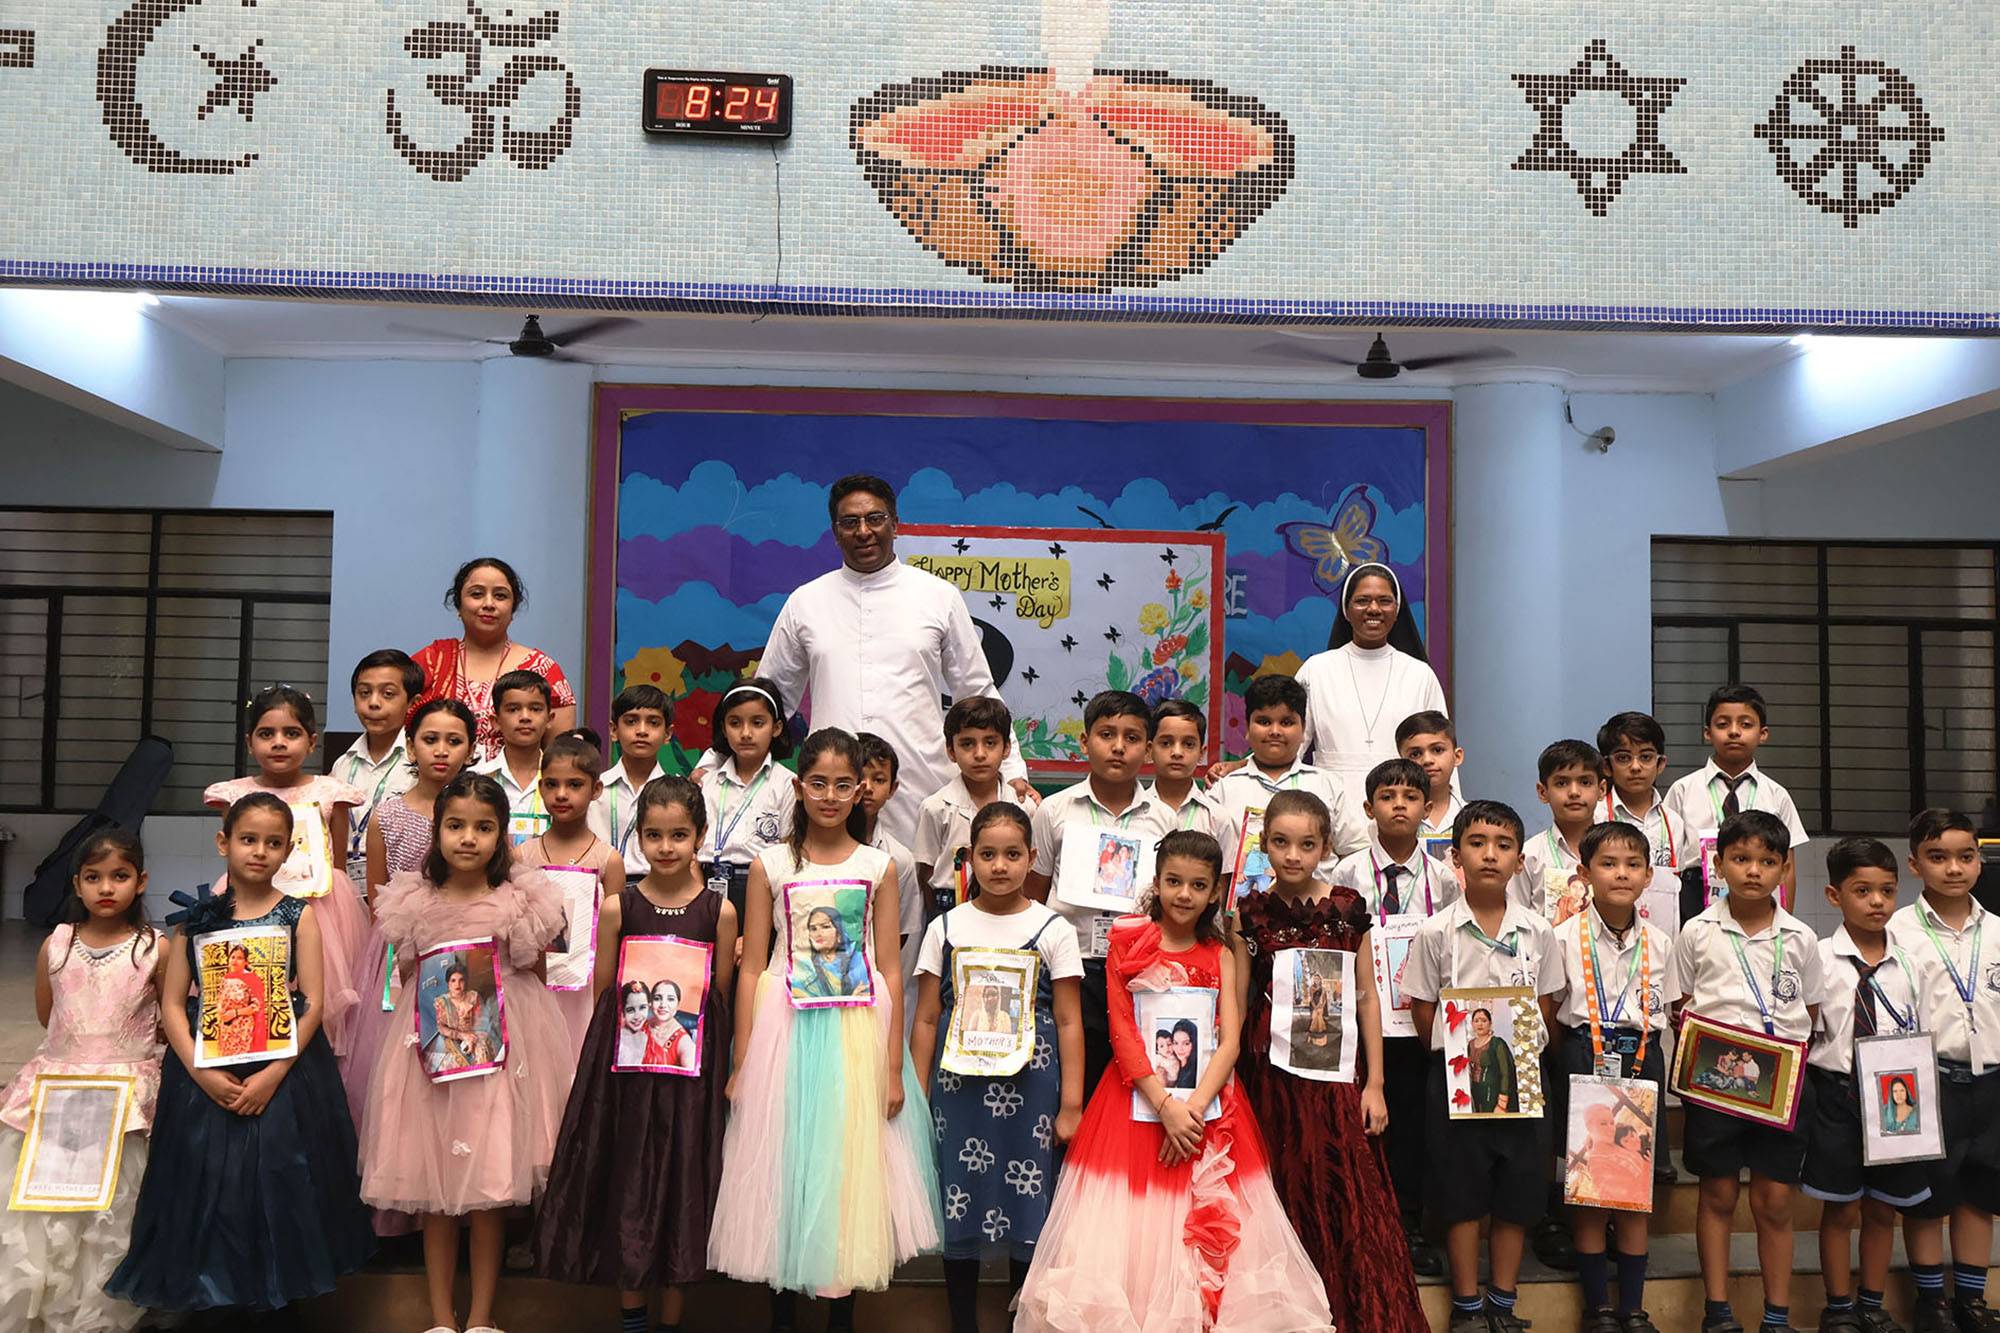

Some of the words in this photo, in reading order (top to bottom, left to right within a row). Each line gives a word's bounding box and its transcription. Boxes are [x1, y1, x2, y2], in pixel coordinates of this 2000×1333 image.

[685, 85, 778, 120] 8:24
[978, 560, 1060, 595] Mother's
[1016, 594, 1063, 629] Day
